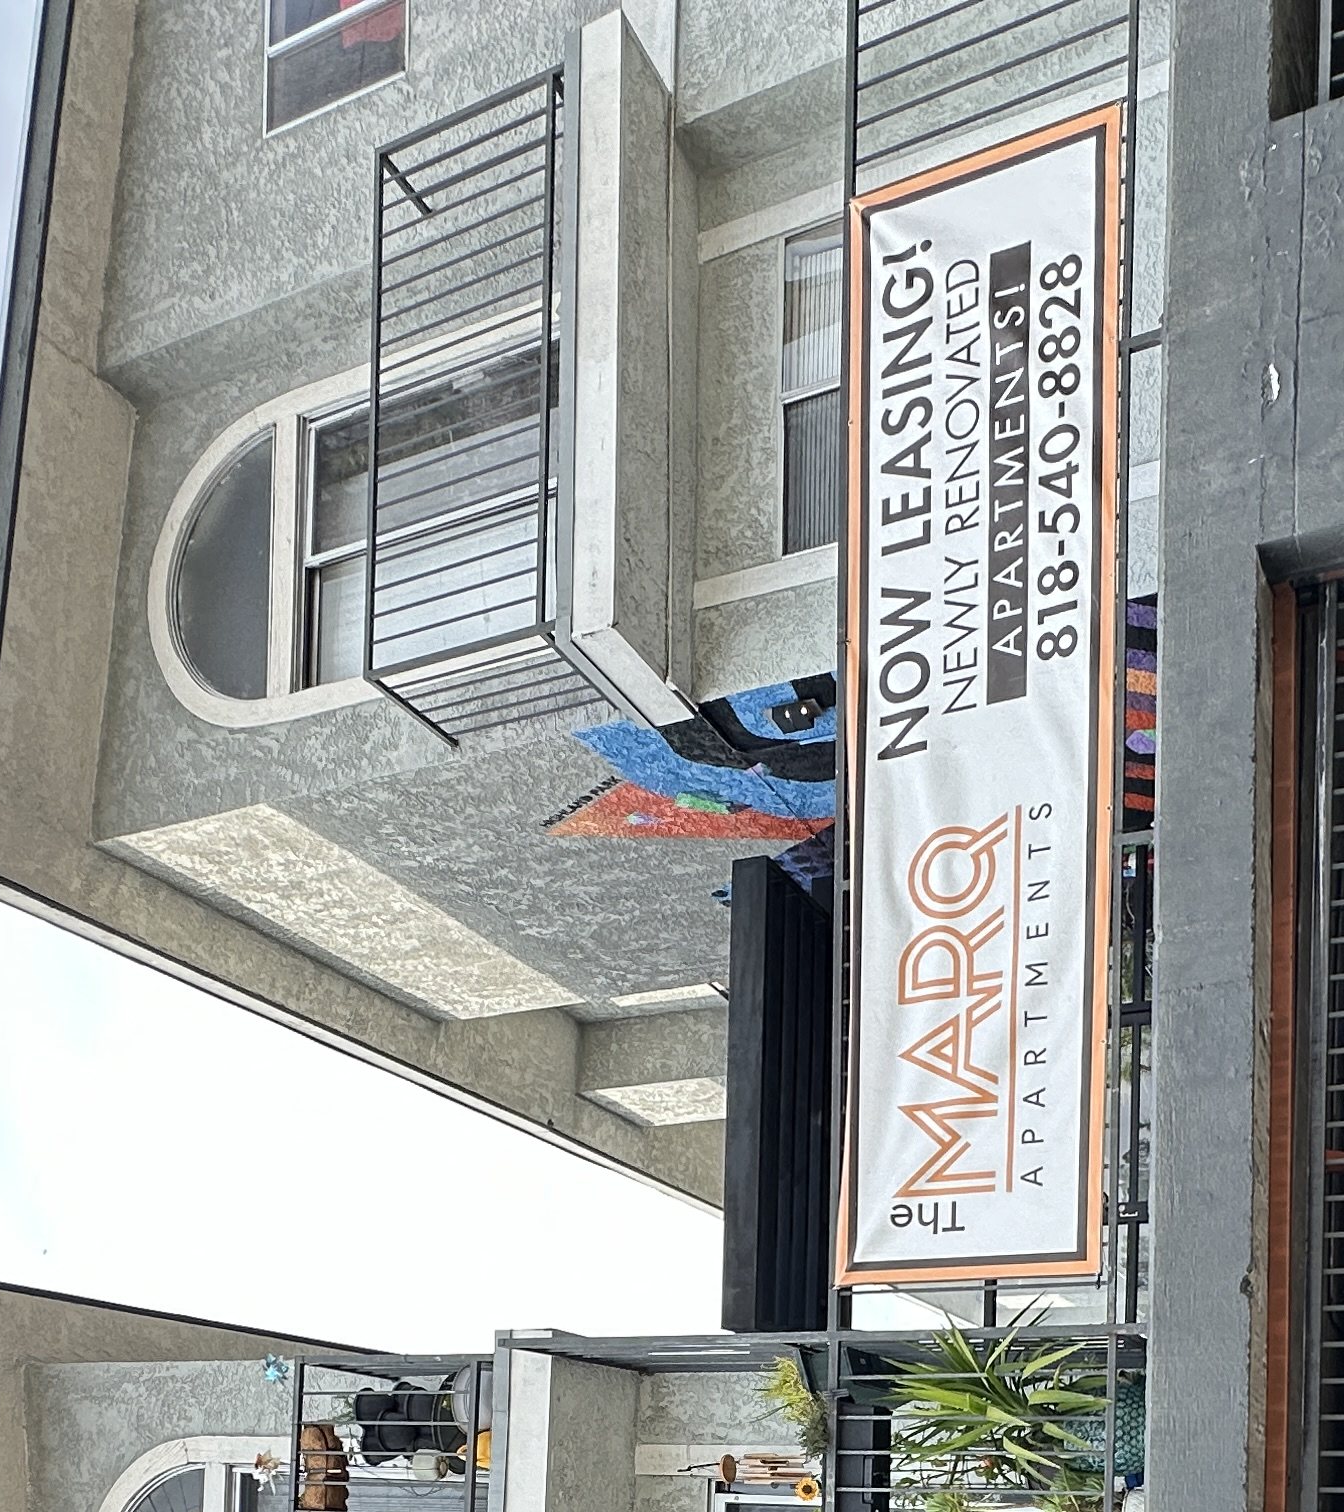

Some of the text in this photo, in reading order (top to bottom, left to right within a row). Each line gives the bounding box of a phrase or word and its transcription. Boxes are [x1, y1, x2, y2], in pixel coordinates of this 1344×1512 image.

[877, 238, 935, 761] NOW LEASING!
[941, 258, 982, 715] NEWLY RENOVATED
[992, 282, 1027, 658] APARTMENTS!
[1036, 252, 1083, 661] 818-540-8828
[889, 812, 1009, 1233] The MARQ
[1019, 801, 1054, 1187] APARTMENTS
